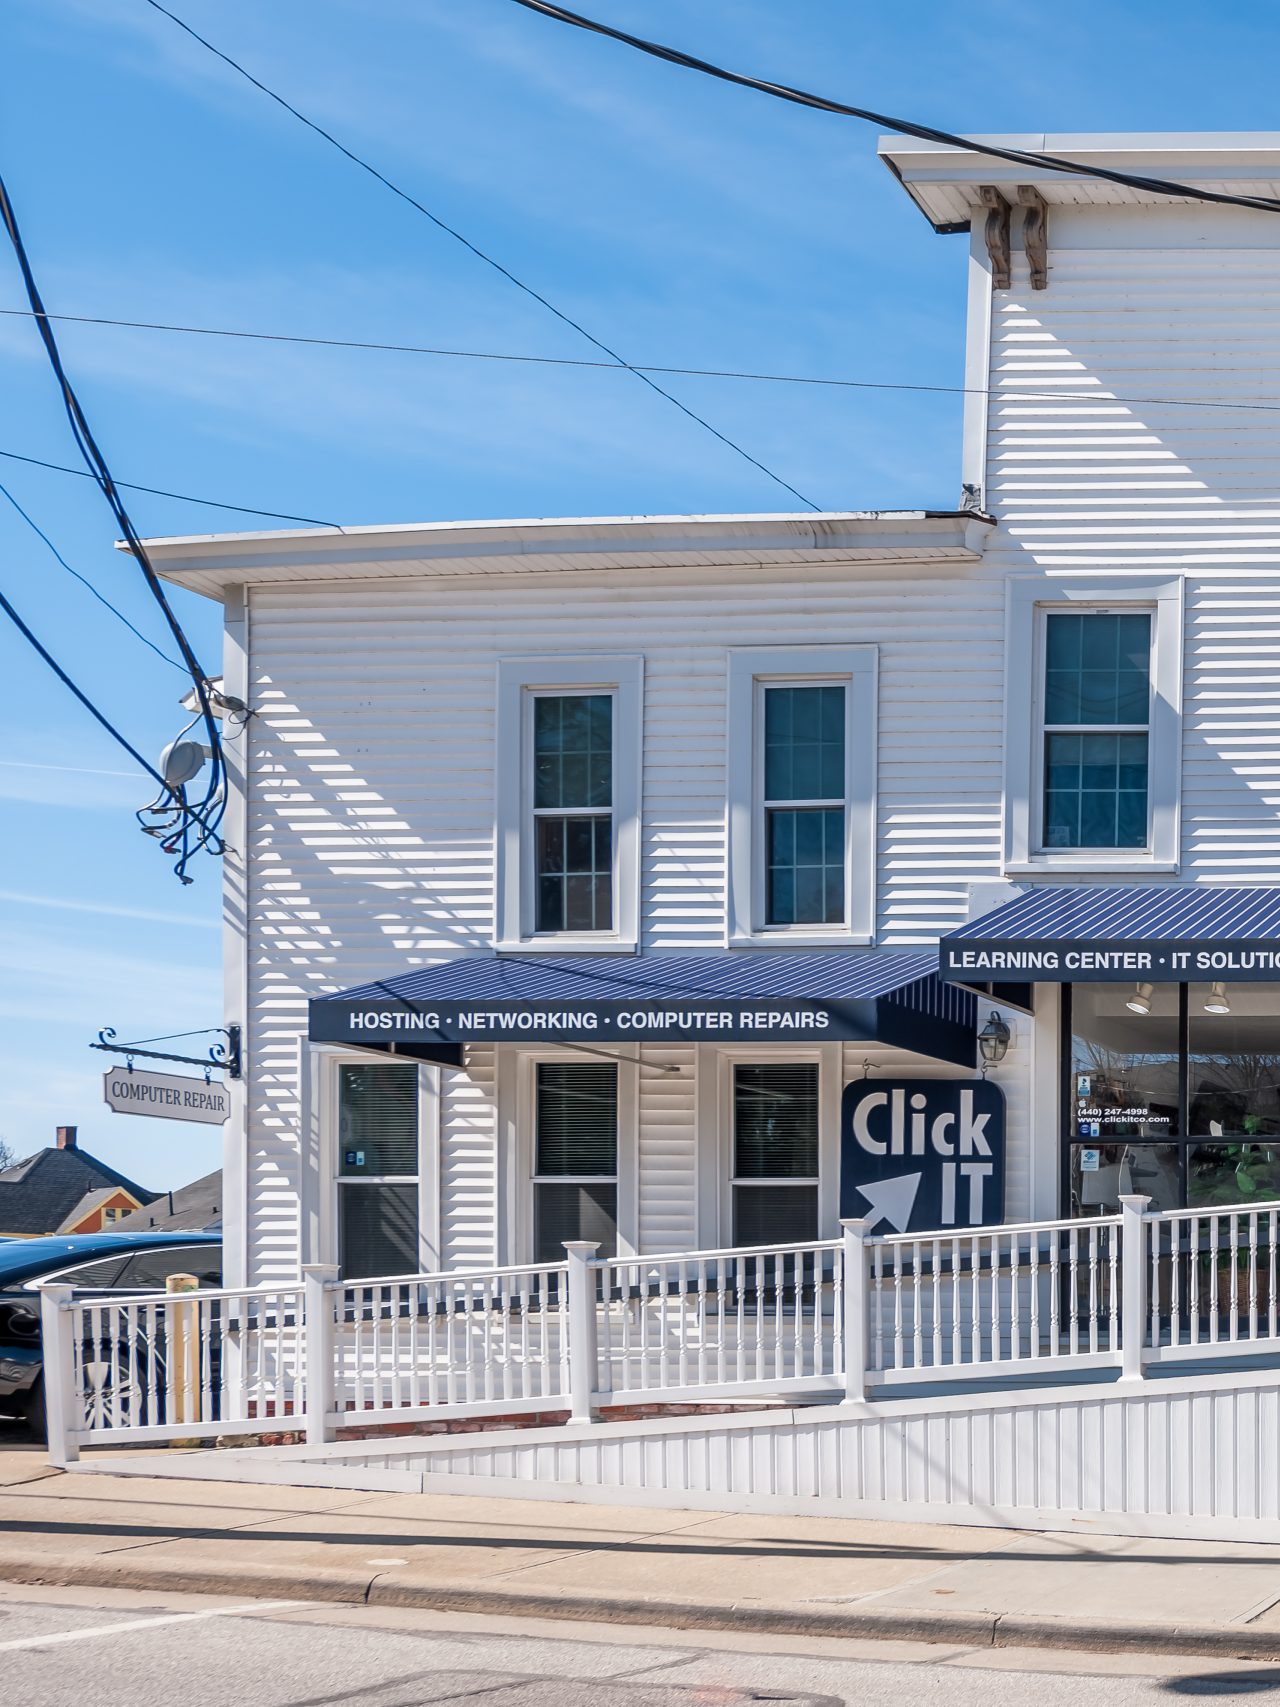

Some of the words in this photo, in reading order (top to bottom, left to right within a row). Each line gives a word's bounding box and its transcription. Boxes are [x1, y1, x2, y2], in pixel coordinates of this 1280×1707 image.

[949, 951, 1059, 969] LEARNING
[1064, 951, 1152, 969] CENTER
[1171, 952, 1192, 969] IT
[349, 1011, 440, 1029] HOSTING
[458, 1012, 598, 1029] NETWORKING
[616, 1011, 733, 1029] COMPUTER
[739, 1011, 829, 1029] REPAIRS
[111, 1081, 181, 1106] COMPUTER
[184, 1090, 225, 1111] REPAIR
[853, 1088, 992, 1156] Click
[1077, 1108, 1102, 1117] (440)
[1104, 1108, 1148, 1116] 247-4998
[941, 1162, 993, 1225] IT
